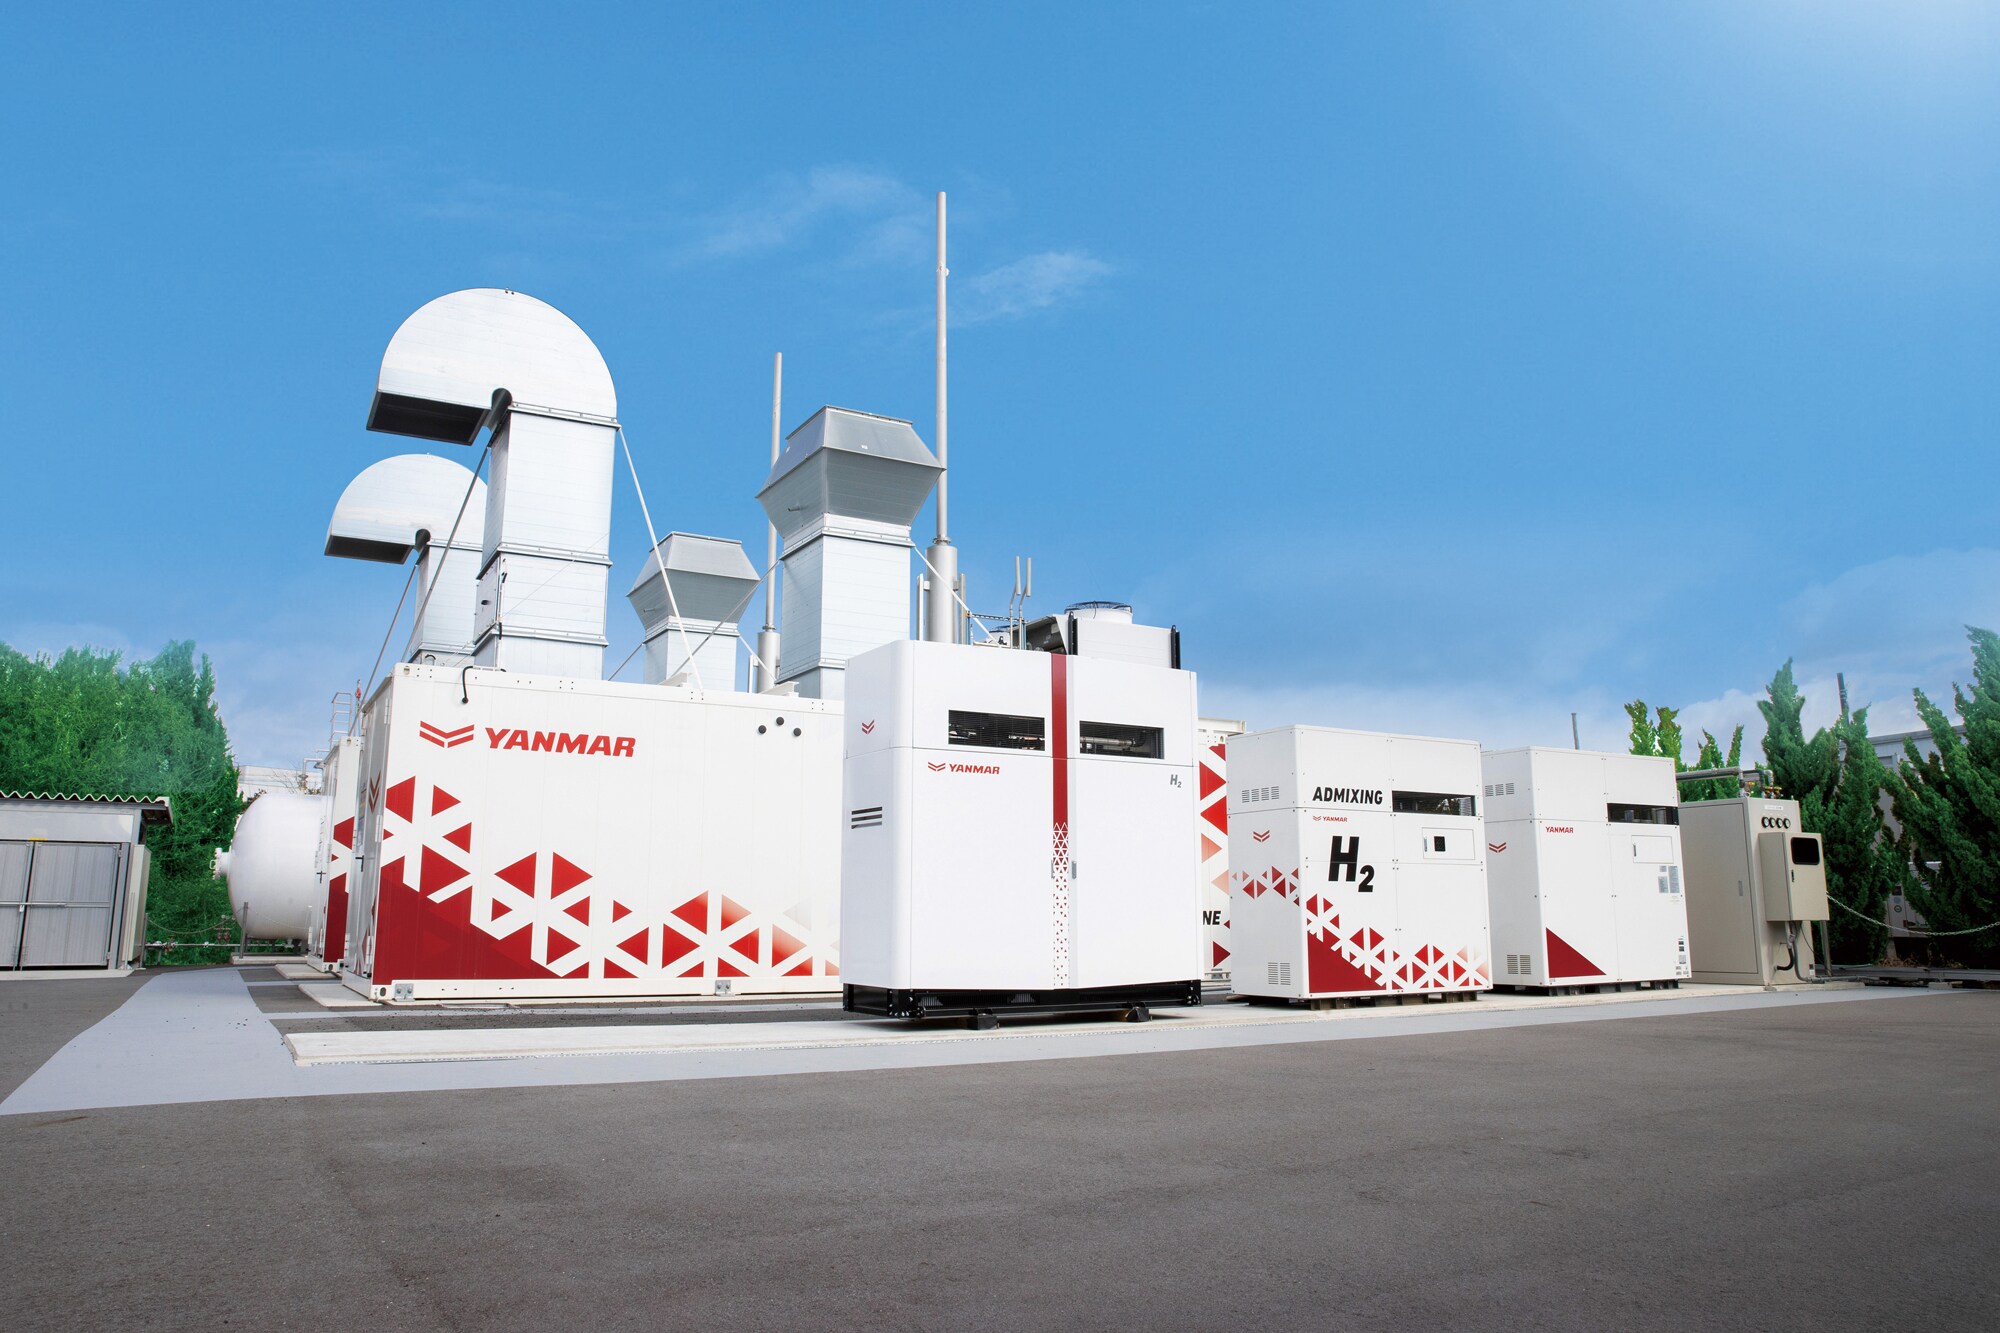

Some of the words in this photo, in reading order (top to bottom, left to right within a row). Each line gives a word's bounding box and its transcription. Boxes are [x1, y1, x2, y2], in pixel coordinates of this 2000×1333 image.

[485, 727, 636, 757] YANMAR
[949, 763, 1000, 775] YANMAR
[1169, 774, 1183, 788] H2
[1312, 786, 1383, 805] ADMIXING
[1546, 826, 1574, 834] YANMAR
[1328, 835, 1375, 893] H2
